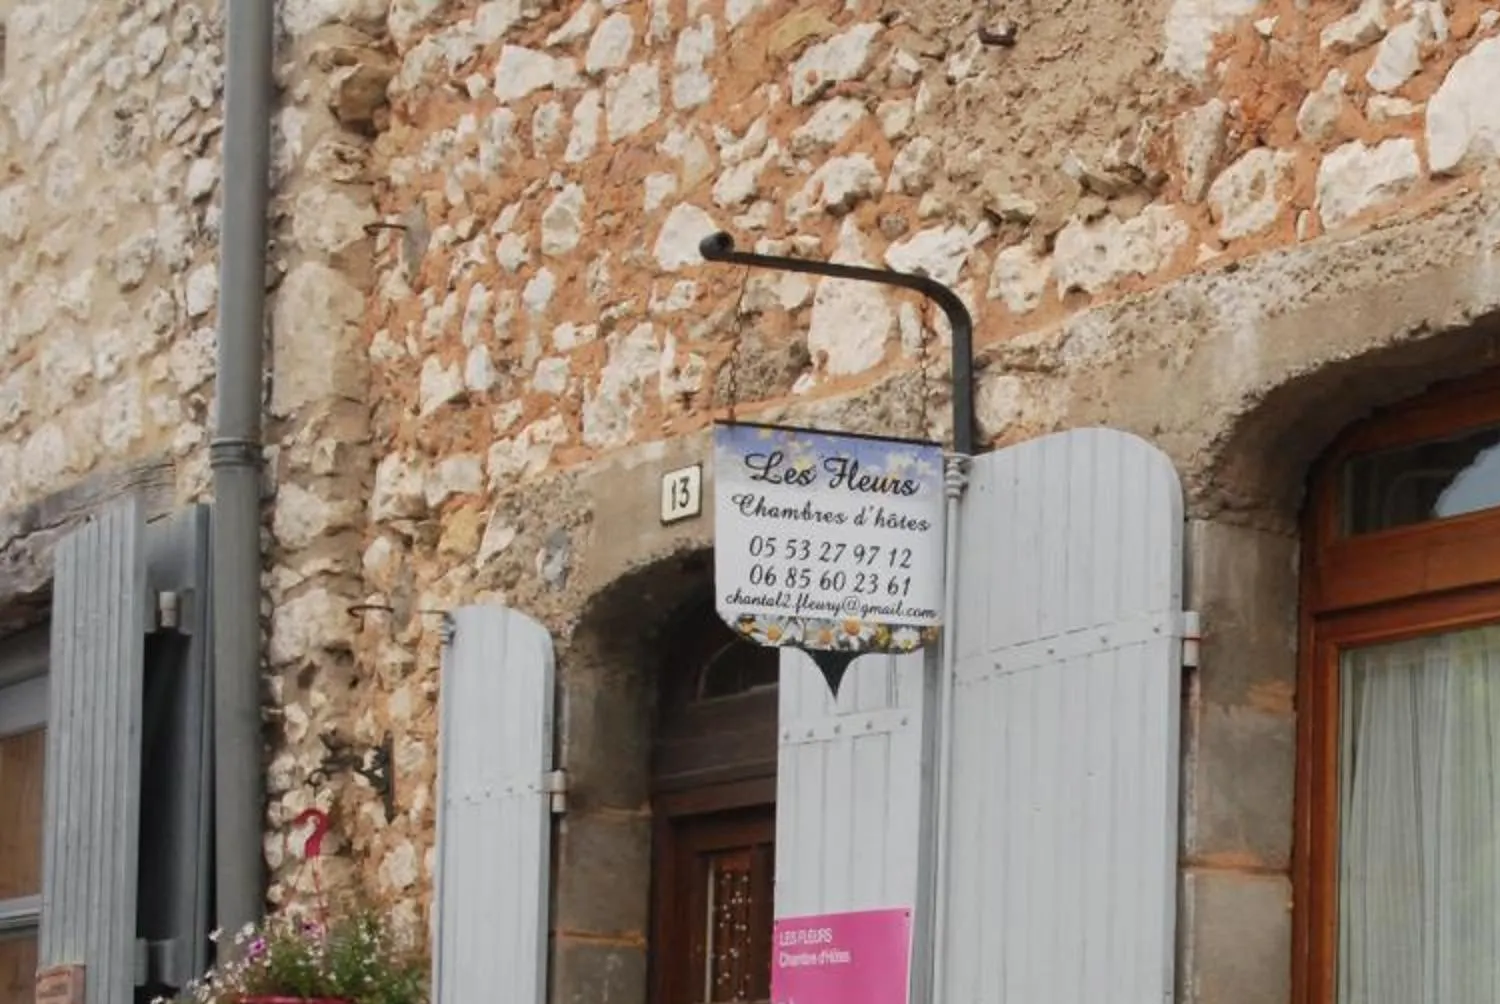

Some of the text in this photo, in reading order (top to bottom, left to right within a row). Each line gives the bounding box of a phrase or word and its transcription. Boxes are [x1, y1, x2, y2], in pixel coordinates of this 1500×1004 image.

[745, 451, 921, 496] Les Fleurs
[671, 475, 691, 511] 13
[731, 493, 931, 531] Chambres d'hôtes
[749, 535, 912, 569] 05 53 27 97 12
[749, 563, 912, 598] 06 85 60 23 61
